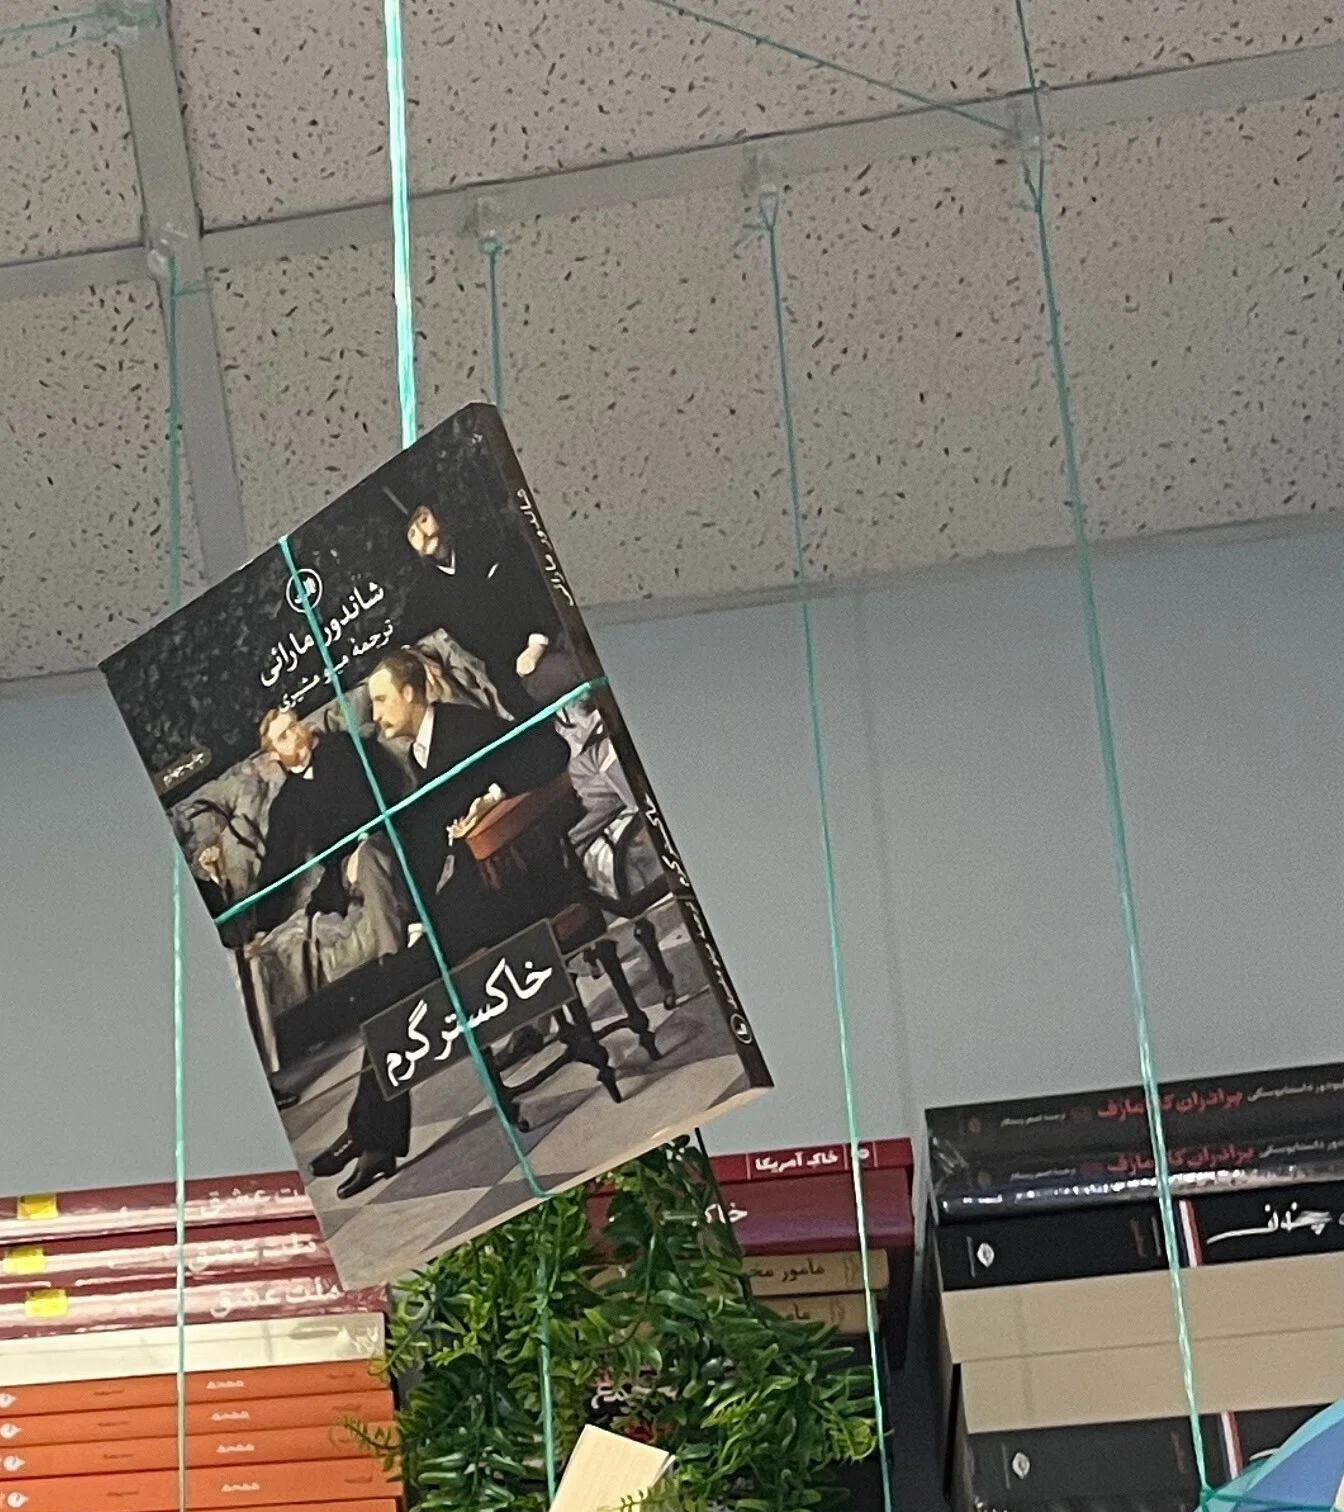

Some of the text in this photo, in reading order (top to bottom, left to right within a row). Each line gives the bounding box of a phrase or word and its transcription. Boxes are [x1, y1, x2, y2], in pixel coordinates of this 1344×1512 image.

[324, 581, 385, 646] شاندور
[385, 957, 553, 1087] خاکستر گرم
[755, 1150, 839, 1173] خاک آمریکا
[280, 1277, 345, 1304] ملت
